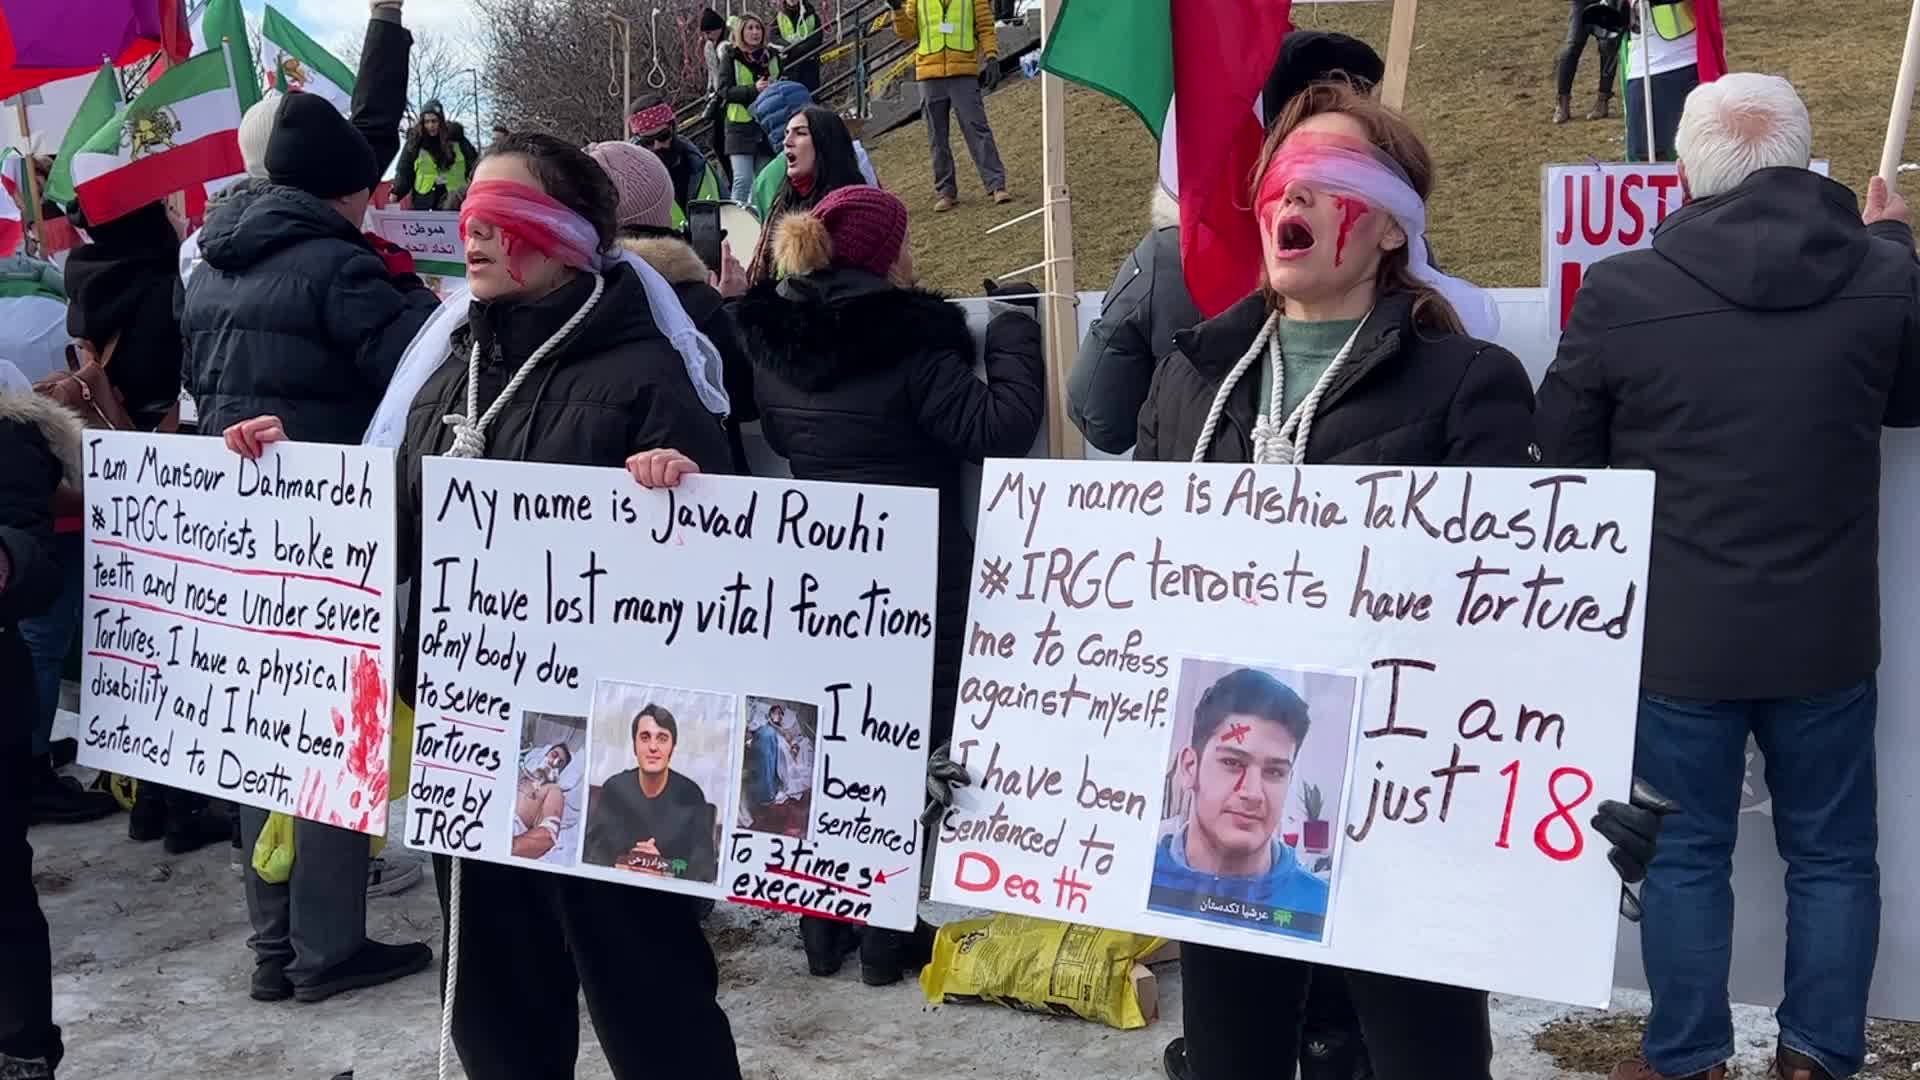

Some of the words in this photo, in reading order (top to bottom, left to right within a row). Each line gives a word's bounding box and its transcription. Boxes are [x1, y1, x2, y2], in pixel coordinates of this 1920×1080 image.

[1556, 173, 1685, 246] JUST
[88, 438, 103, 478] I
[103, 459, 128, 482] am
[136, 446, 225, 492] Mansour
[237, 450, 373, 509] Dahmardeh
[986, 471, 1046, 548] My
[1067, 479, 1164, 517] name
[1184, 472, 1211, 516] is
[1222, 467, 1347, 527] Arshia
[173, 500, 257, 560] terrorists
[274, 515, 334, 570] broke
[346, 540, 379, 590] my
[436, 476, 498, 551] My
[513, 489, 593, 522] name
[612, 489, 638, 524] is
[651, 489, 758, 544] Javad
[776, 488, 889, 553] Rouhi
[92, 551, 135, 593] teeth
[143, 563, 178, 605] and
[184, 580, 229, 617] nose
[431, 556, 461, 614] I
[468, 557, 529, 622] have
[546, 549, 608, 625] lost
[613, 596, 684, 646] many
[696, 571, 774, 640] vital
[789, 572, 932, 639] functions
[1146, 536, 1328, 609] terrorists
[1350, 545, 1433, 622] have
[167, 625, 184, 668] I
[191, 628, 227, 676] have
[237, 659, 251, 676] a
[258, 647, 348, 696] physical
[421, 618, 448, 657] of
[443, 631, 472, 672] my
[475, 623, 527, 687] body
[536, 641, 580, 689] due
[968, 621, 1017, 659] me
[1032, 610, 1065, 667] to
[91, 662, 169, 721] disability
[173, 683, 213, 728] and
[221, 686, 241, 734] I
[245, 689, 291, 750] have
[296, 708, 345, 761] been
[416, 671, 438, 709] to
[823, 683, 853, 742] I
[861, 682, 921, 751] have
[960, 673, 1092, 731] against
[1363, 658, 1437, 740] I
[1458, 698, 1565, 750] am
[186, 738, 207, 777] to
[217, 749, 295, 807] Death.
[411, 766, 455, 808] done
[463, 777, 492, 821] by
[822, 753, 887, 806] been
[980, 742, 1064, 801] have
[1076, 753, 1147, 821] been
[1345, 742, 1481, 843] just
[1495, 758, 1595, 862] 18
[410, 807, 484, 853] IRGC
[1079, 823, 1115, 876] to
[732, 871, 872, 918] execution
[953, 851, 1093, 914] Death
